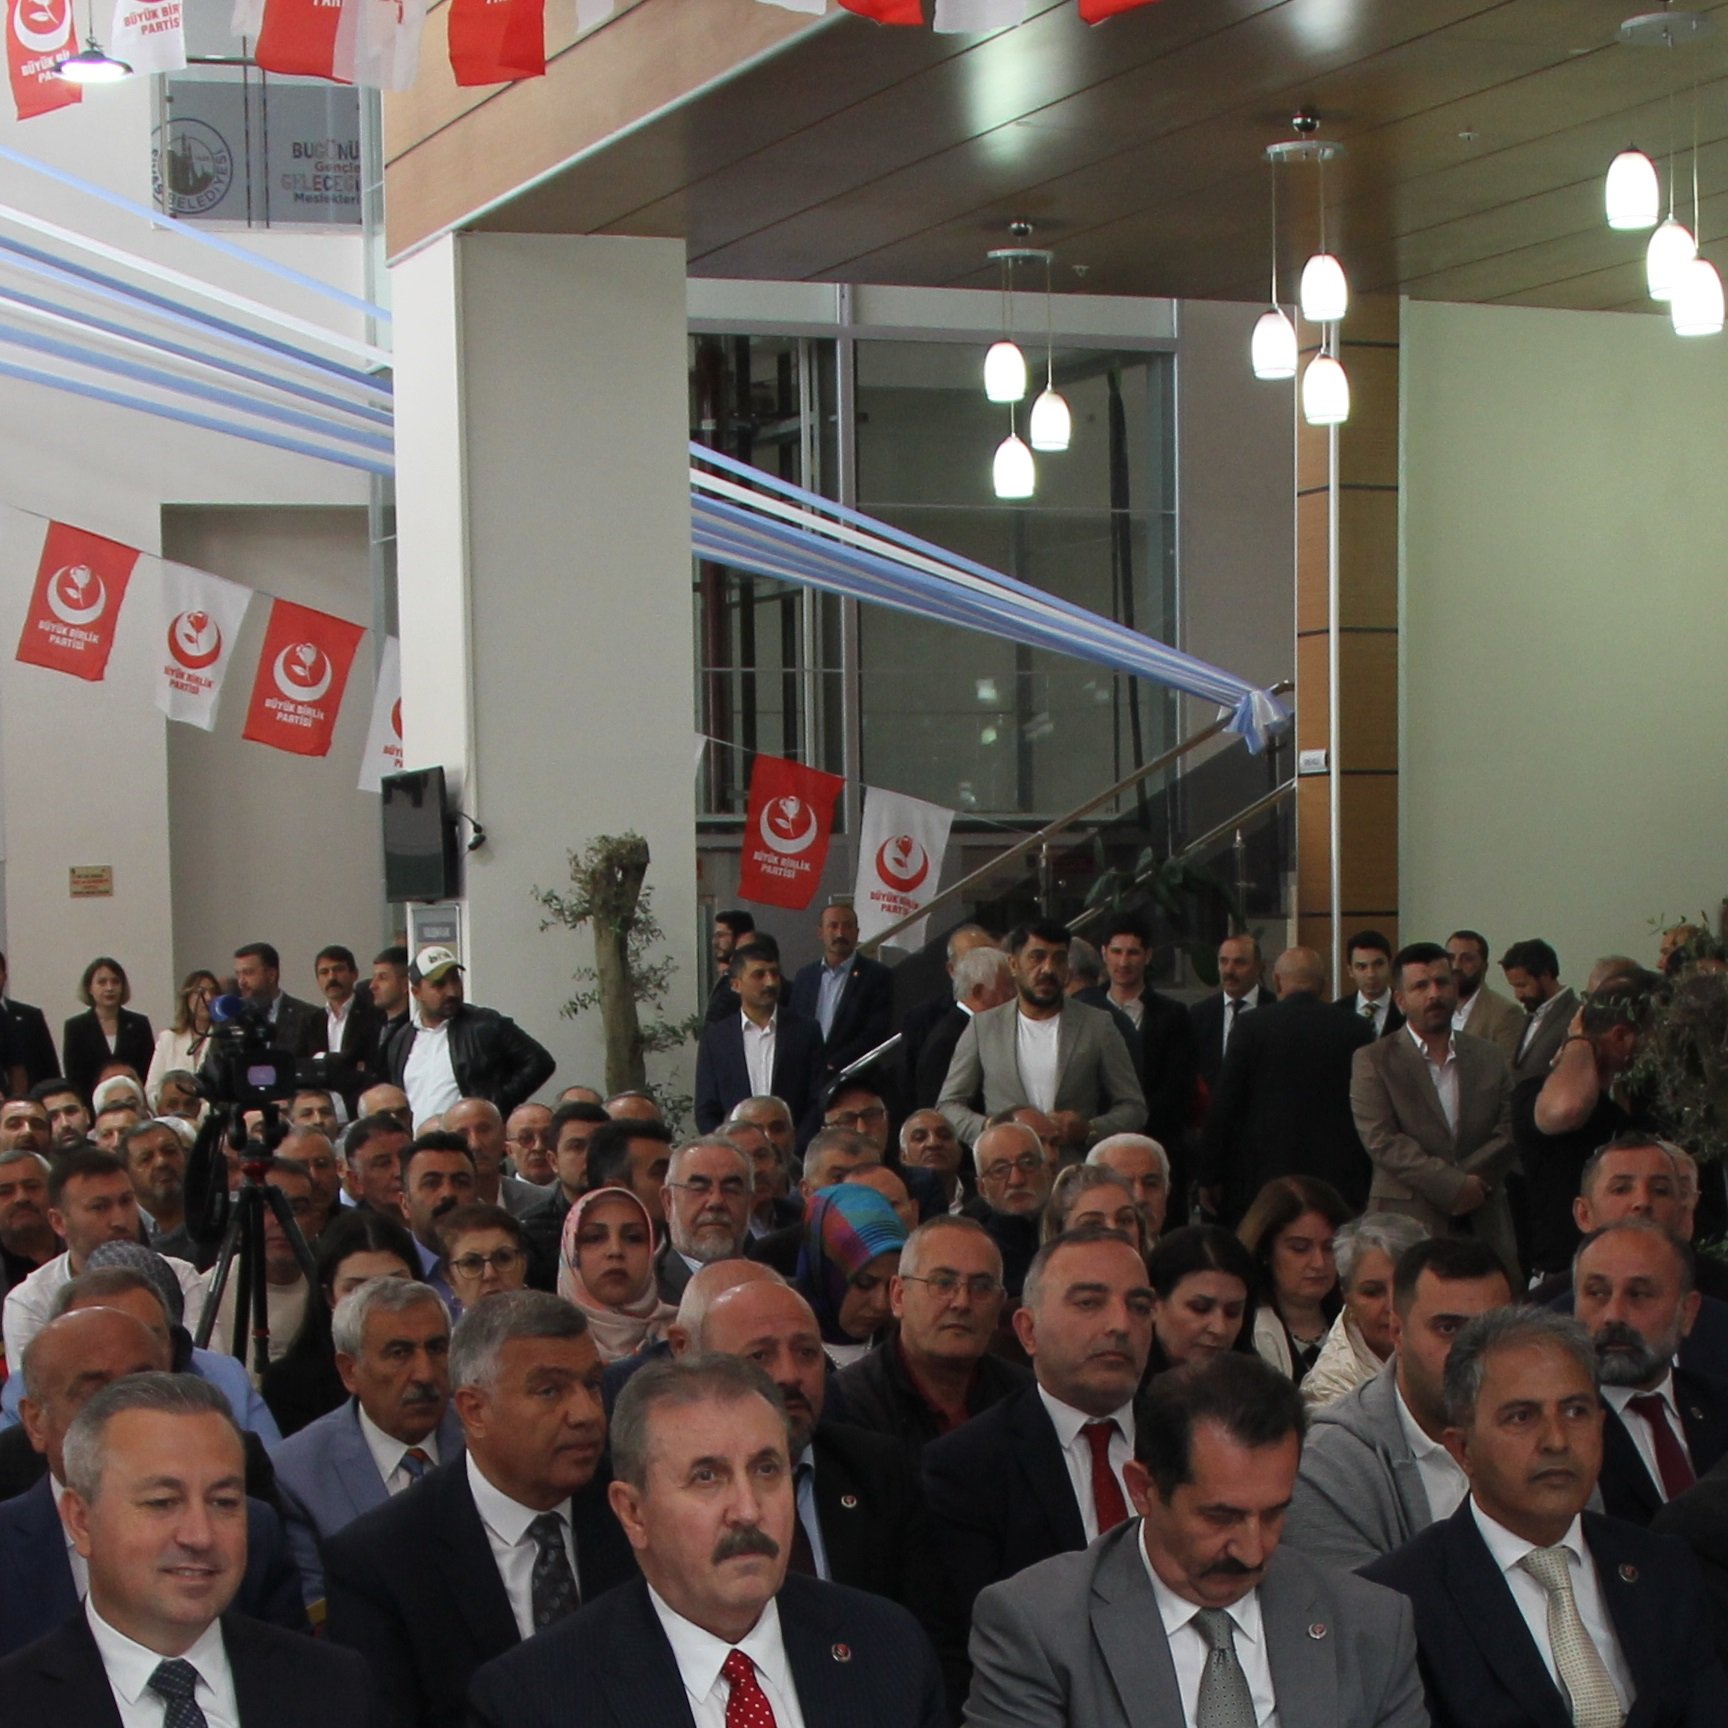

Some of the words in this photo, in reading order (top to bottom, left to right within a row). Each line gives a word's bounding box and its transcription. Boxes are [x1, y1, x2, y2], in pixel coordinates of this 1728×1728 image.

[124, 9, 160, 28] BÜYÜK
[160, 3, 181, 20] BİR
[141, 18, 181, 35] PARTİS
[21, 55, 55, 77] BÜYÜK
[38, 619, 67, 635] BÜYÜK
[69, 627, 100, 644] BİRLİK
[49, 635, 85, 650] PARTİSİ
[264, 697, 296, 713] BÜYÜK
[297, 703, 325, 720] BİRLİK
[276, 712, 313, 728] PARTİSİ
[383, 745, 403, 758] BÜY
[753, 851, 780, 864] BÜYÜK
[781, 857, 812, 872] BİRLİK
[761, 865, 797, 880] PARTİSİ
